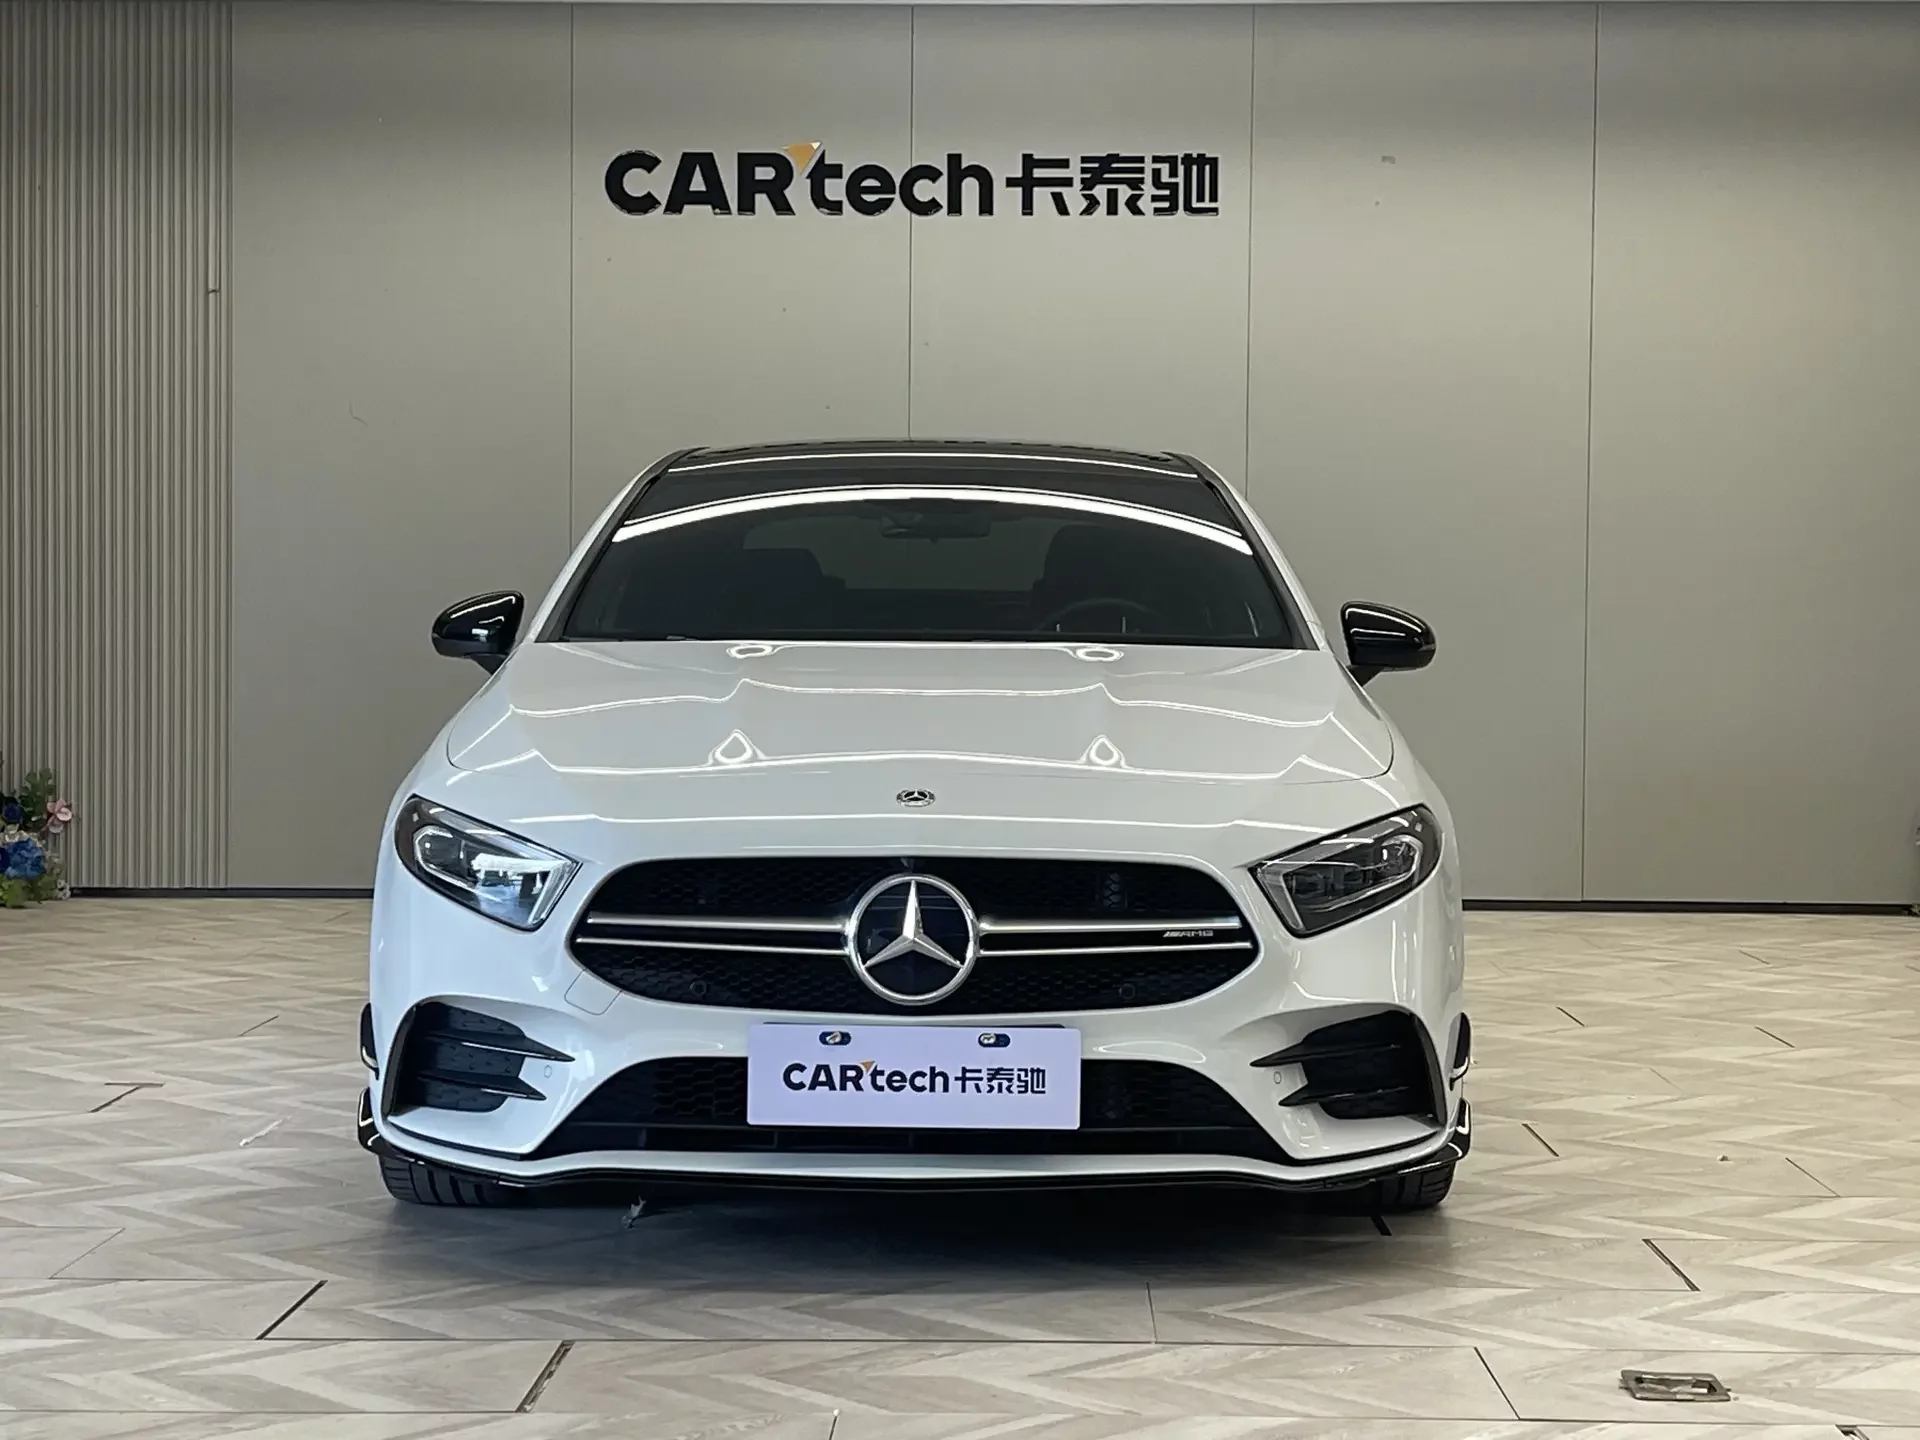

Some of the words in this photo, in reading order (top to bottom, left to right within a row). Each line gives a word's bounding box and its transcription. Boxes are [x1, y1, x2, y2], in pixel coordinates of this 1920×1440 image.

[604, 147, 994, 217] CARtech
[1005, 153, 1219, 217] 卡泰驰
[1176, 930, 1214, 938] AMG
[782, 1060, 950, 1094] CARtech
[954, 1066, 1047, 1095] 卡泰驰
